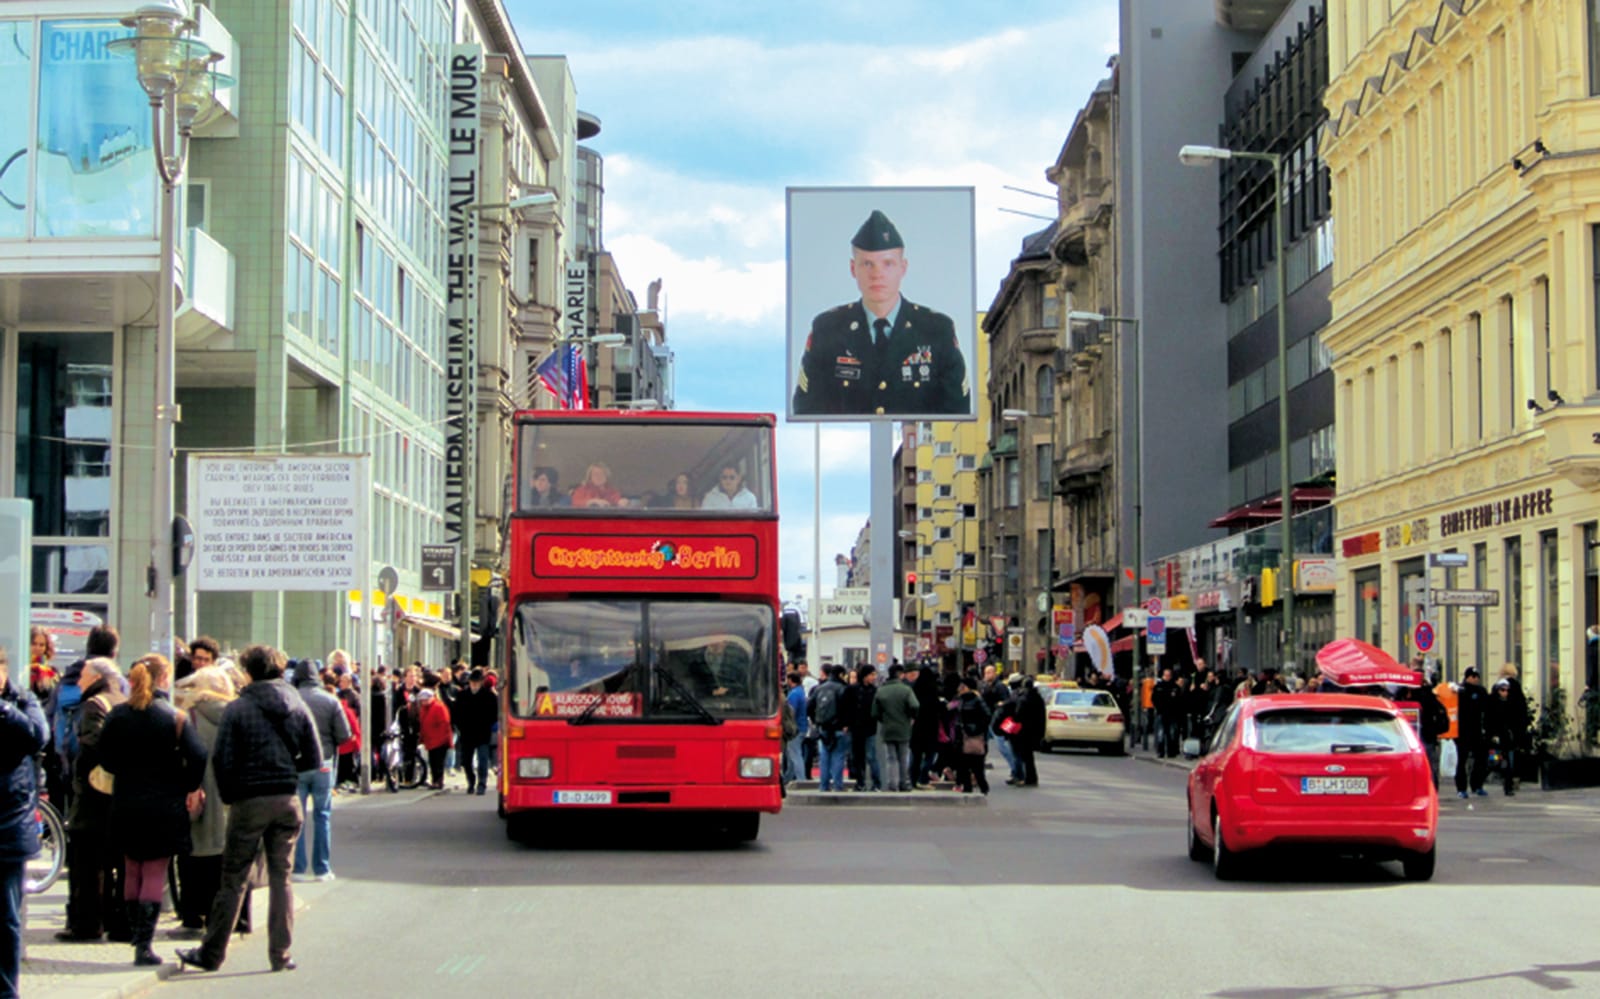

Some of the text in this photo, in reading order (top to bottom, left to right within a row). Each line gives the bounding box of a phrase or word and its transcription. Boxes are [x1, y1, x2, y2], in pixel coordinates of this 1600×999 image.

[452, 54, 477, 119] MUR
[451, 128, 476, 155] LE
[449, 170, 475, 245] WALL
[448, 254, 473, 303] THE
[1441, 504, 1492, 537] EINSTEIN
[1503, 488, 1553, 523] KAFFEE
[678, 545, 741, 569] Berlin
[540, 693, 554, 715] A
